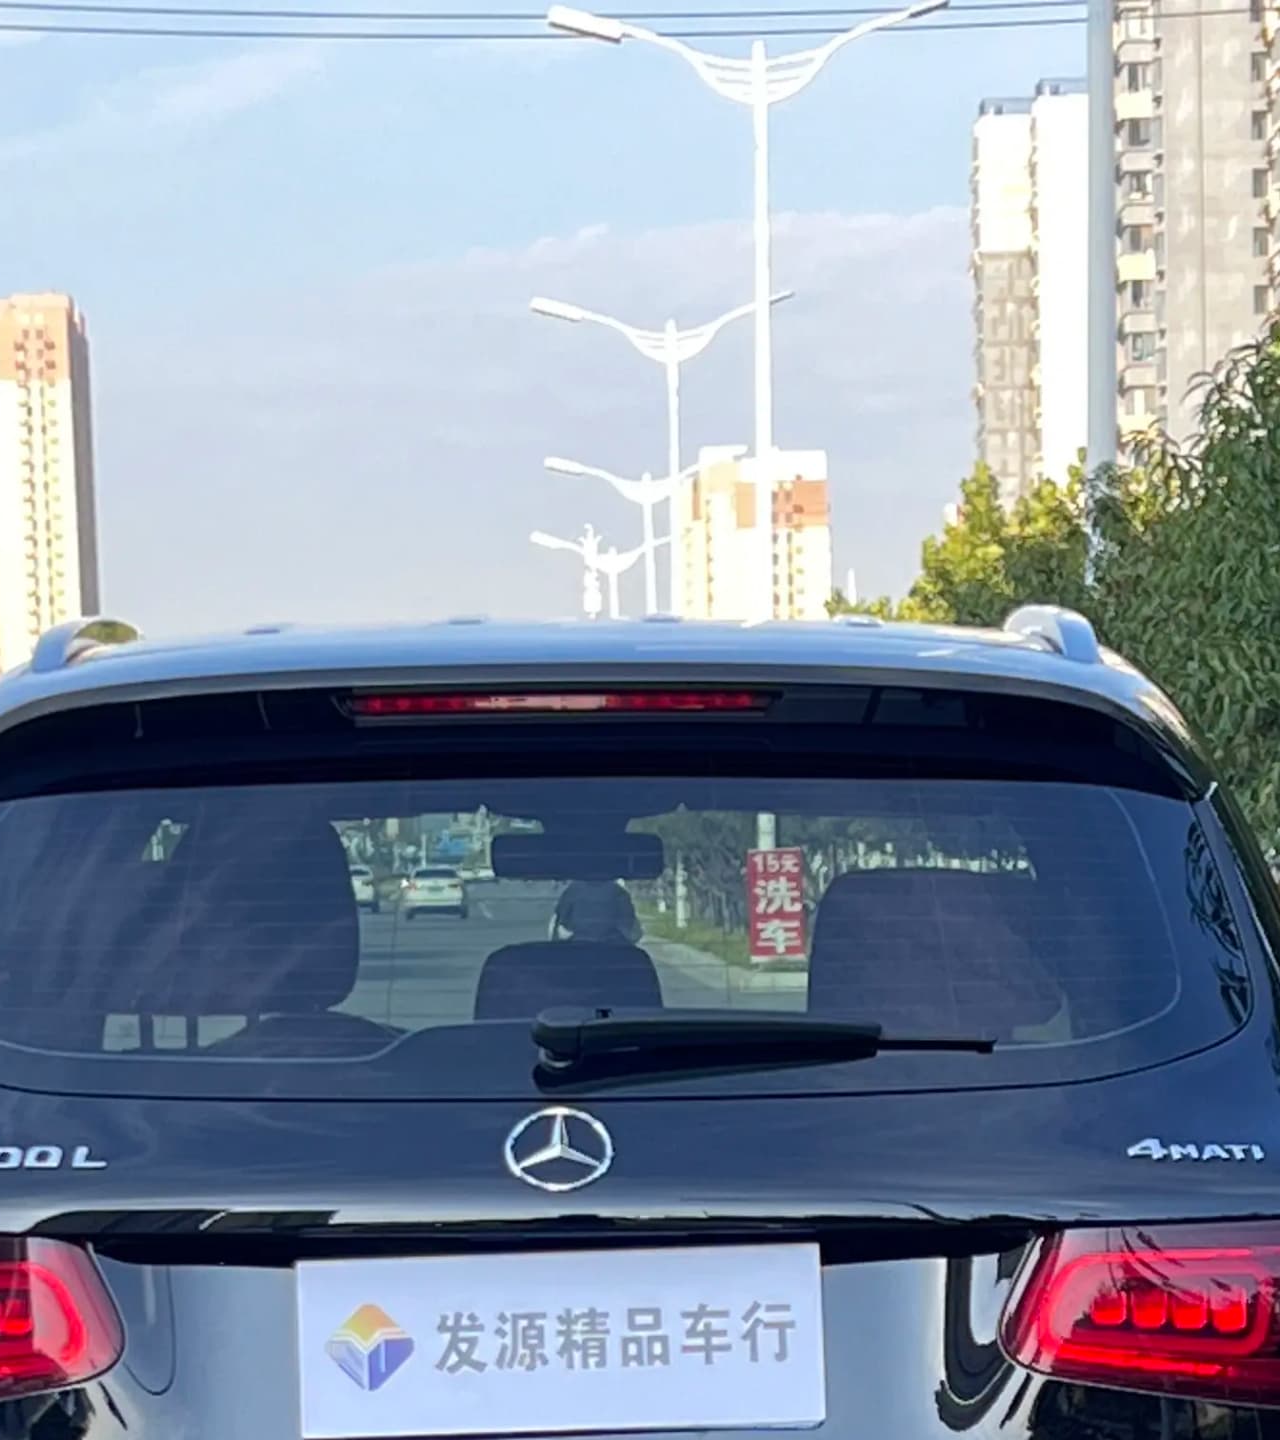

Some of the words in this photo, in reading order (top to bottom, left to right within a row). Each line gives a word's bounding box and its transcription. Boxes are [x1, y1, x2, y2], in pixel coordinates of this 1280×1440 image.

[752, 853, 800, 874] 15元
[753, 875, 803, 954] 洗车
[1126, 1137, 1265, 1161] 4MATI
[434, 1300, 798, 1374] 发源精品车行
